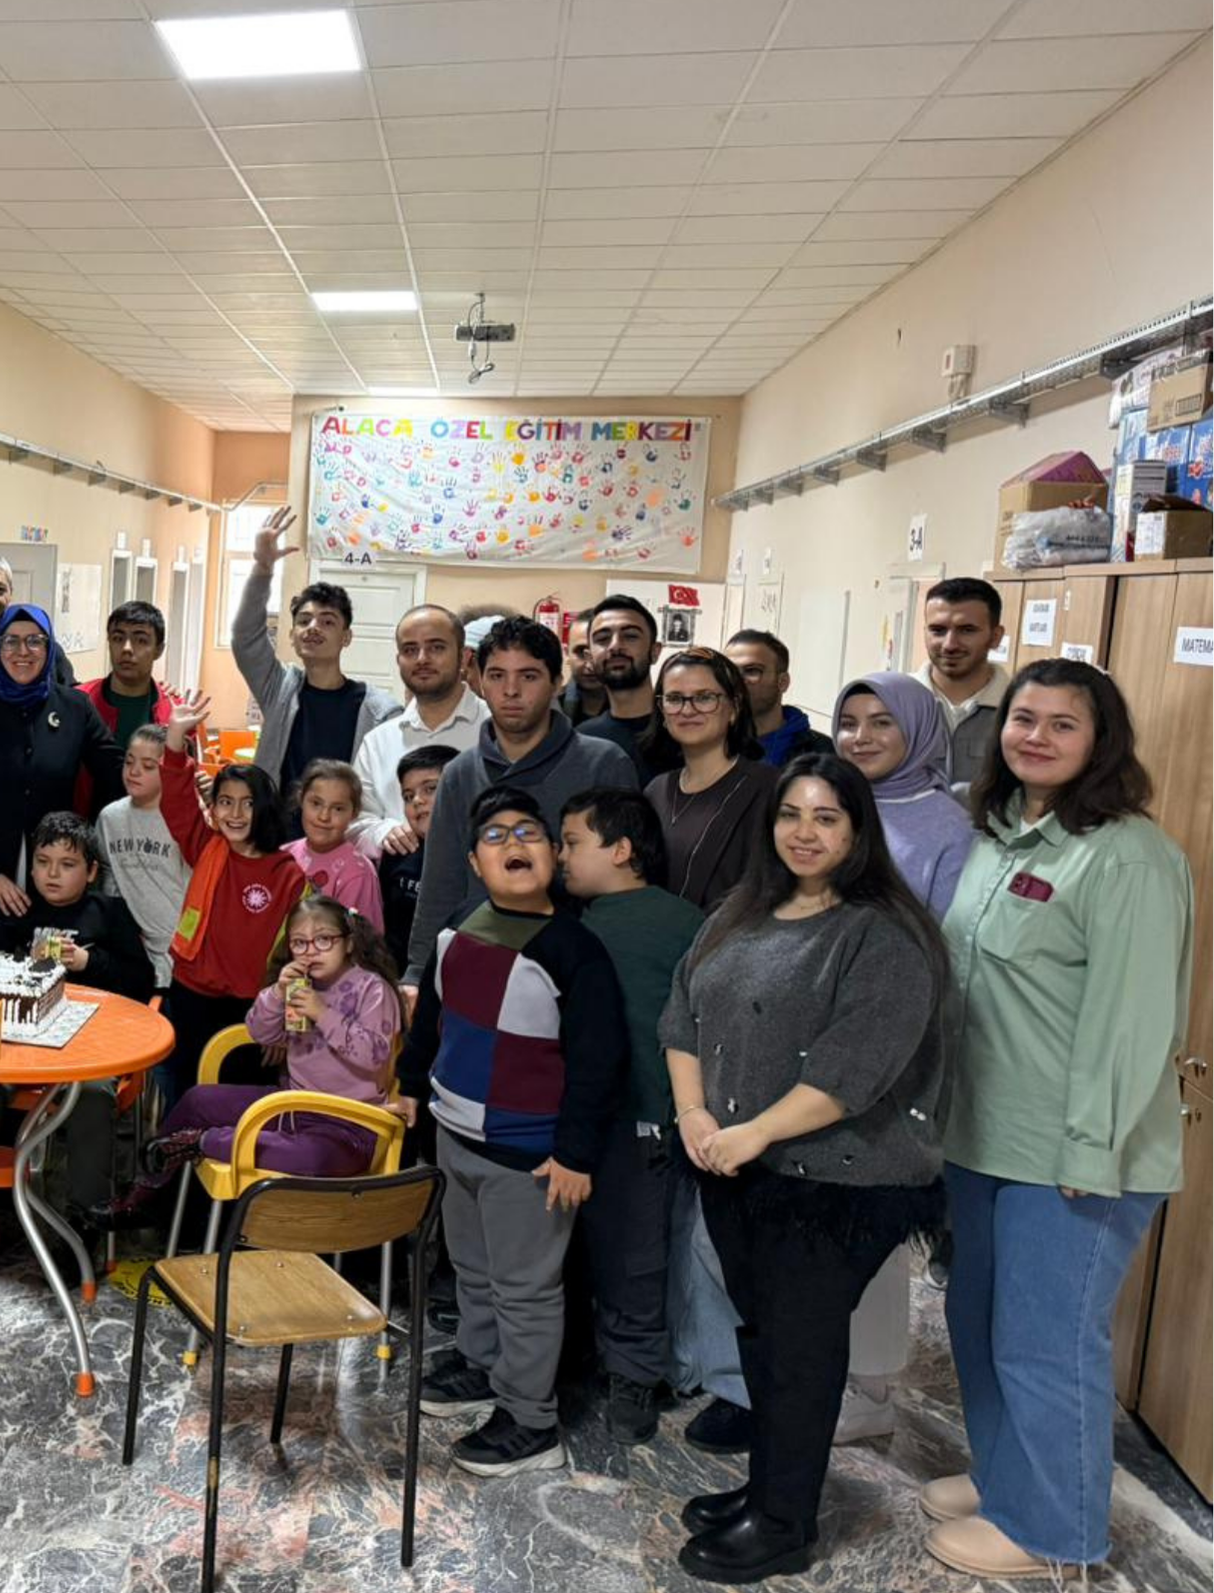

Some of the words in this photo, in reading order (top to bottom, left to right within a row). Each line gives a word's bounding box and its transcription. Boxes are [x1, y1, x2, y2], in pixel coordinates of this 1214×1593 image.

[321, 416, 413, 438] ALACA
[504, 418, 582, 441] EĞİTİM
[591, 419, 691, 441] MERKEZİ
[345, 551, 372, 565] 4-A
[109, 838, 134, 854] NEW
